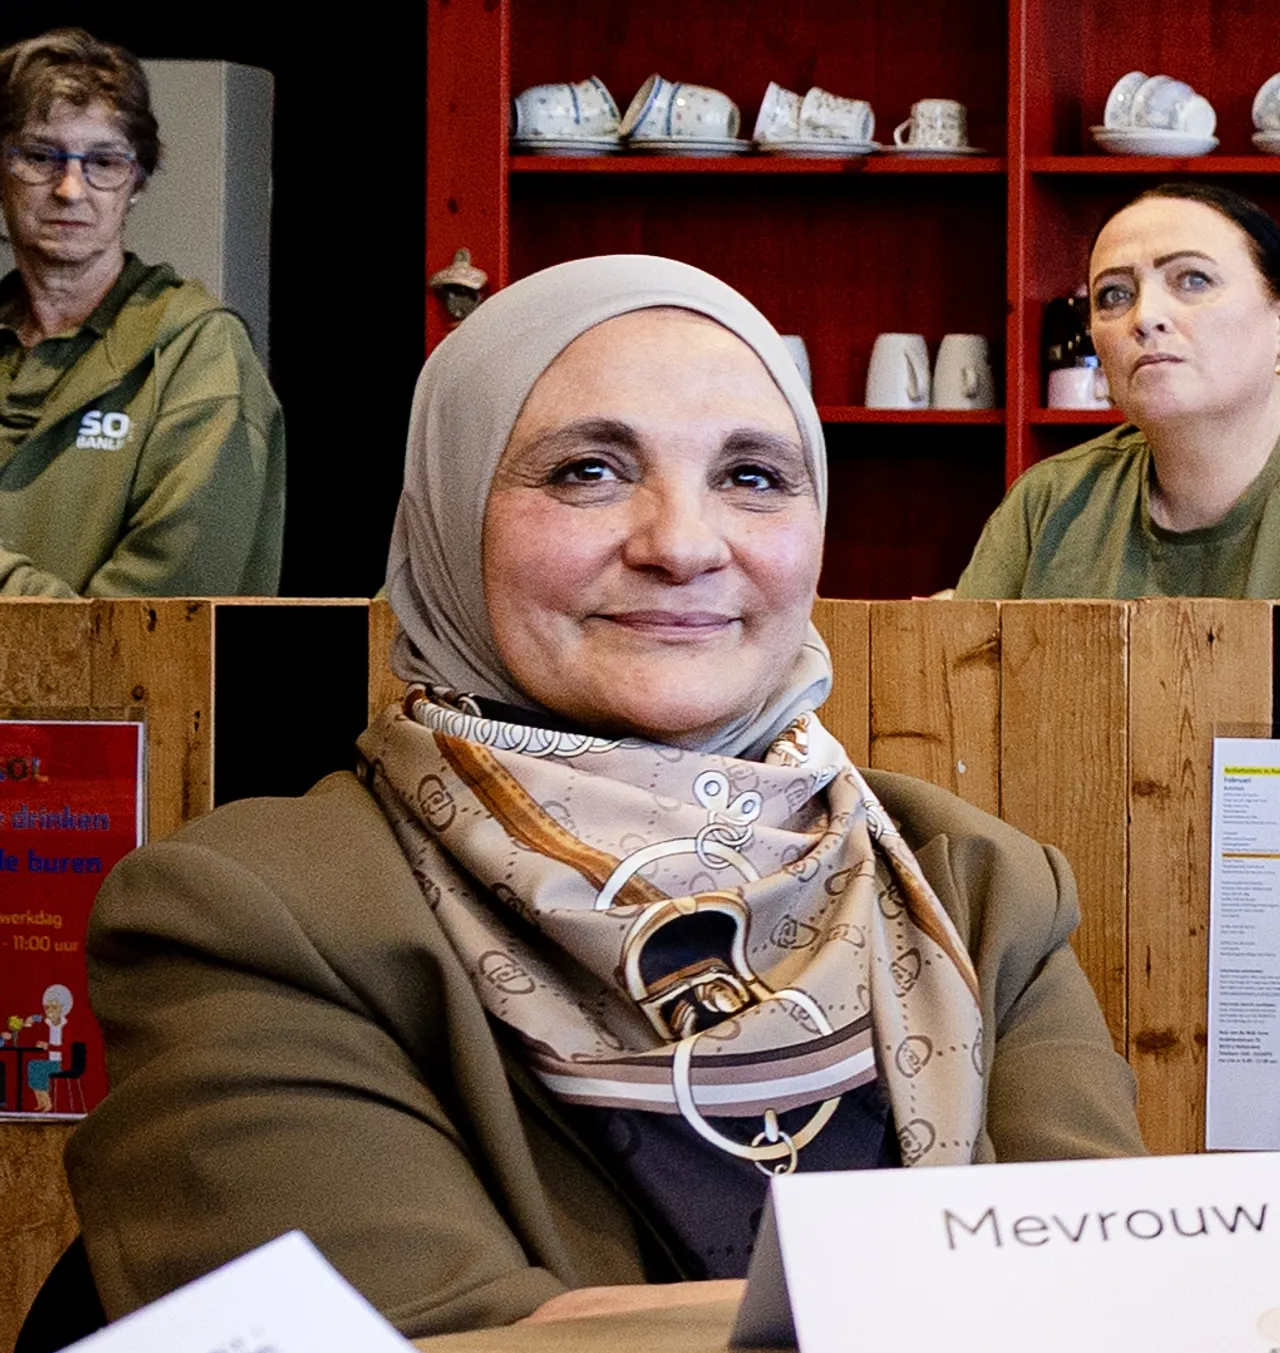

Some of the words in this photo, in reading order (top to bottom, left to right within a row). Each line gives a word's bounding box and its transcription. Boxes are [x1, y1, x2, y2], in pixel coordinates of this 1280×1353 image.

[78, 410, 130, 438] SO
[12, 805, 109, 831] drinken
[28, 849, 102, 874] buren
[13, 935, 51, 952] 11:00
[943, 1201, 1269, 1252] Mevrouw
